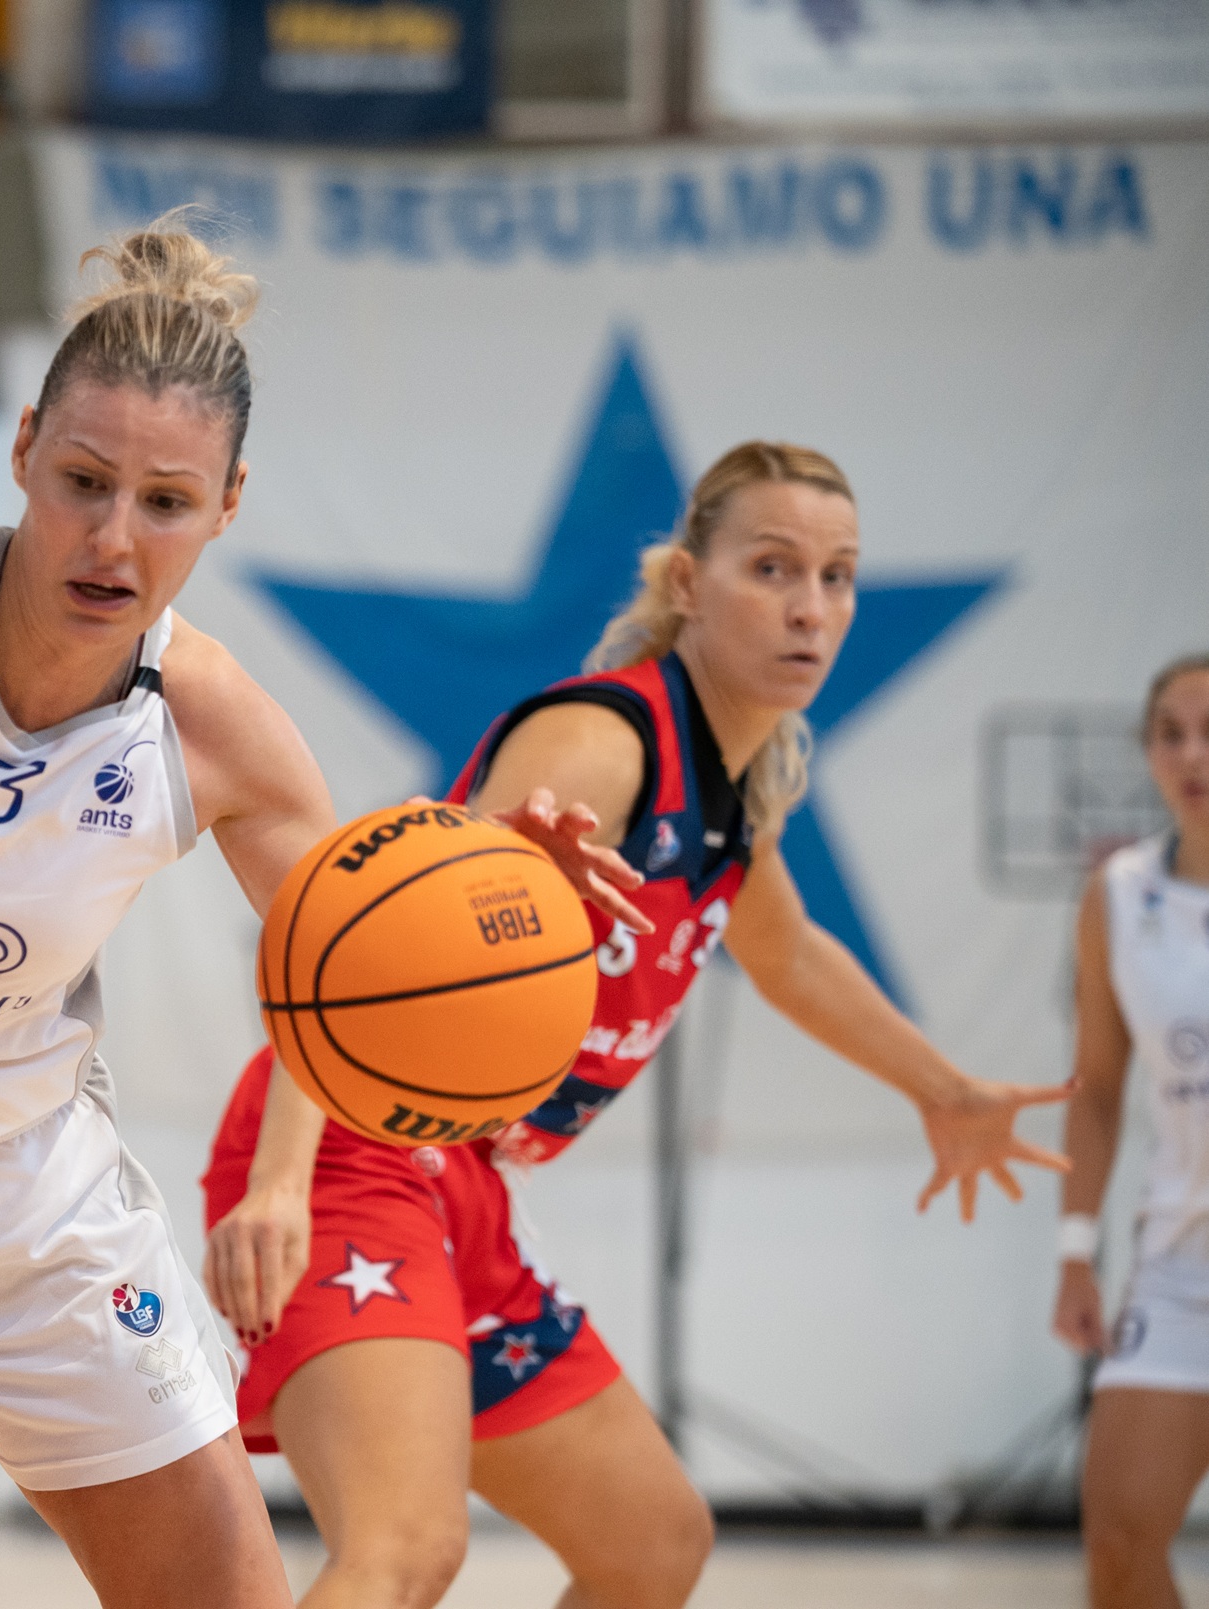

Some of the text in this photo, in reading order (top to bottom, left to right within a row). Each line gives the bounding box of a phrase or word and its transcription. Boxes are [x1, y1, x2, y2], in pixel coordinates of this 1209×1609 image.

[317, 153, 888, 266] SEGUIAMO
[925, 146, 1154, 255] UNA
[79, 808, 133, 830] ants
[331, 807, 480, 873] lson
[477, 902, 542, 946] FIBA
[596, 917, 638, 978] 5
[381, 1103, 505, 1142] Wil
[129, 1304, 154, 1325] LBF
